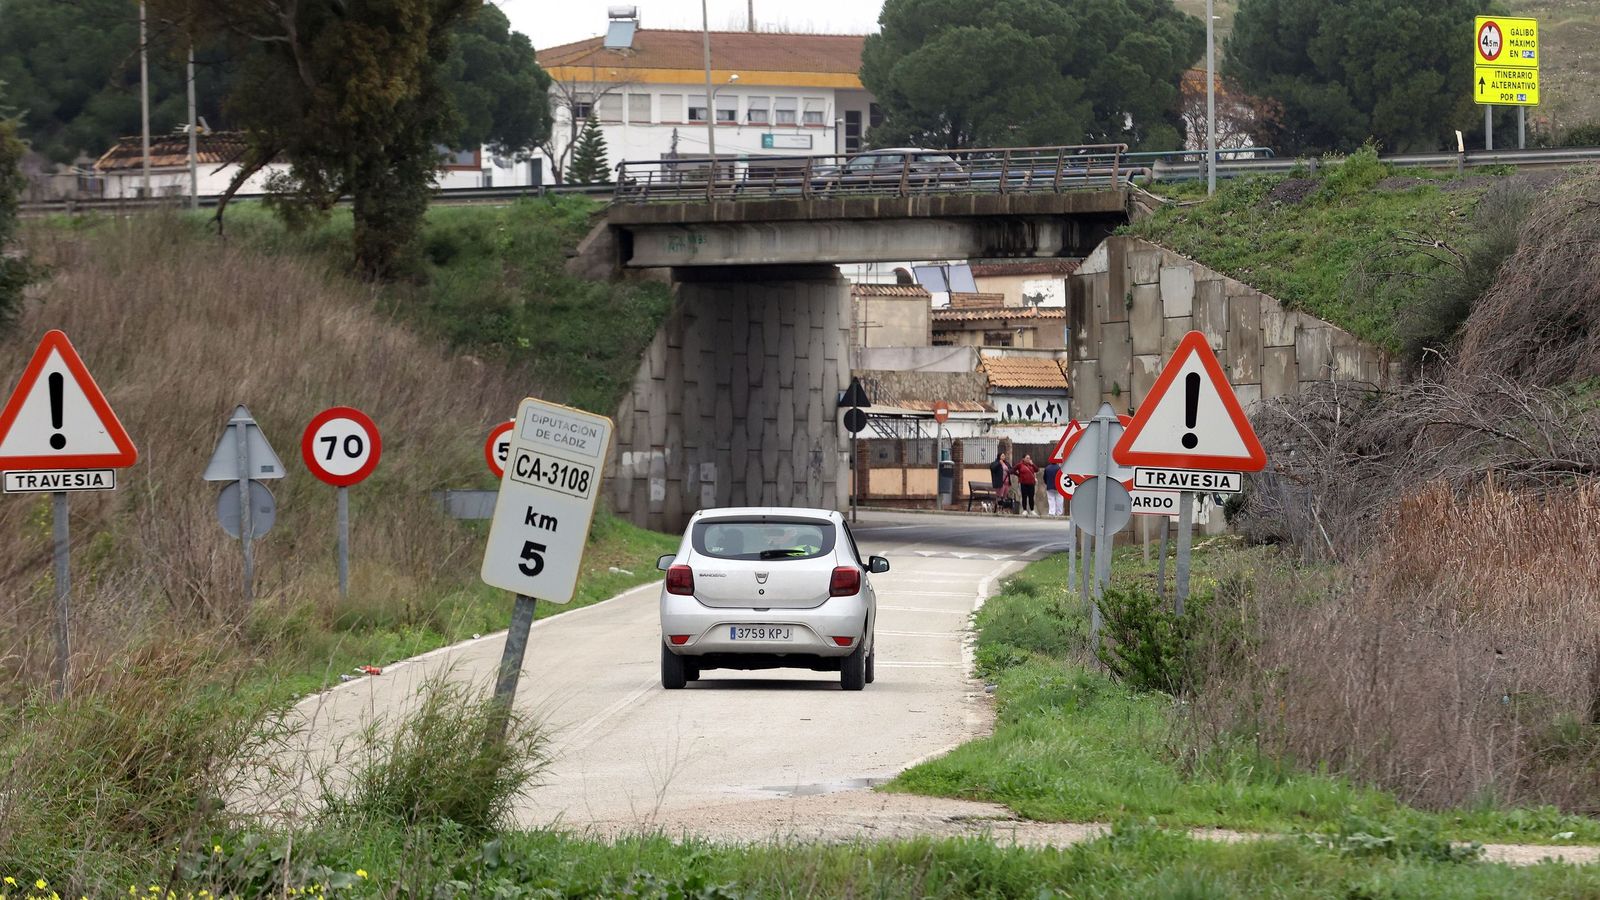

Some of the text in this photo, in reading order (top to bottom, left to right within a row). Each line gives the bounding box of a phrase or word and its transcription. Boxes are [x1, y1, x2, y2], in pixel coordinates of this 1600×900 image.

[1495, 71, 1532, 79] ITINERARIO
[1491, 81, 1536, 89] ALTERNATIVO
[1500, 93, 1513, 101] POR
[320, 434, 363, 460] 70
[536, 429, 586, 449] DE CÁDIZ
[498, 442, 510, 461] 5
[15, 473, 104, 488] TRAVESIA
[516, 454, 590, 493] CA-3108
[1145, 472, 1231, 488] TRAVESIA
[1130, 496, 1173, 509] ARDO
[524, 506, 558, 532] km
[518, 540, 547, 577] 5
[738, 628, 790, 639] 3759 KPJ
